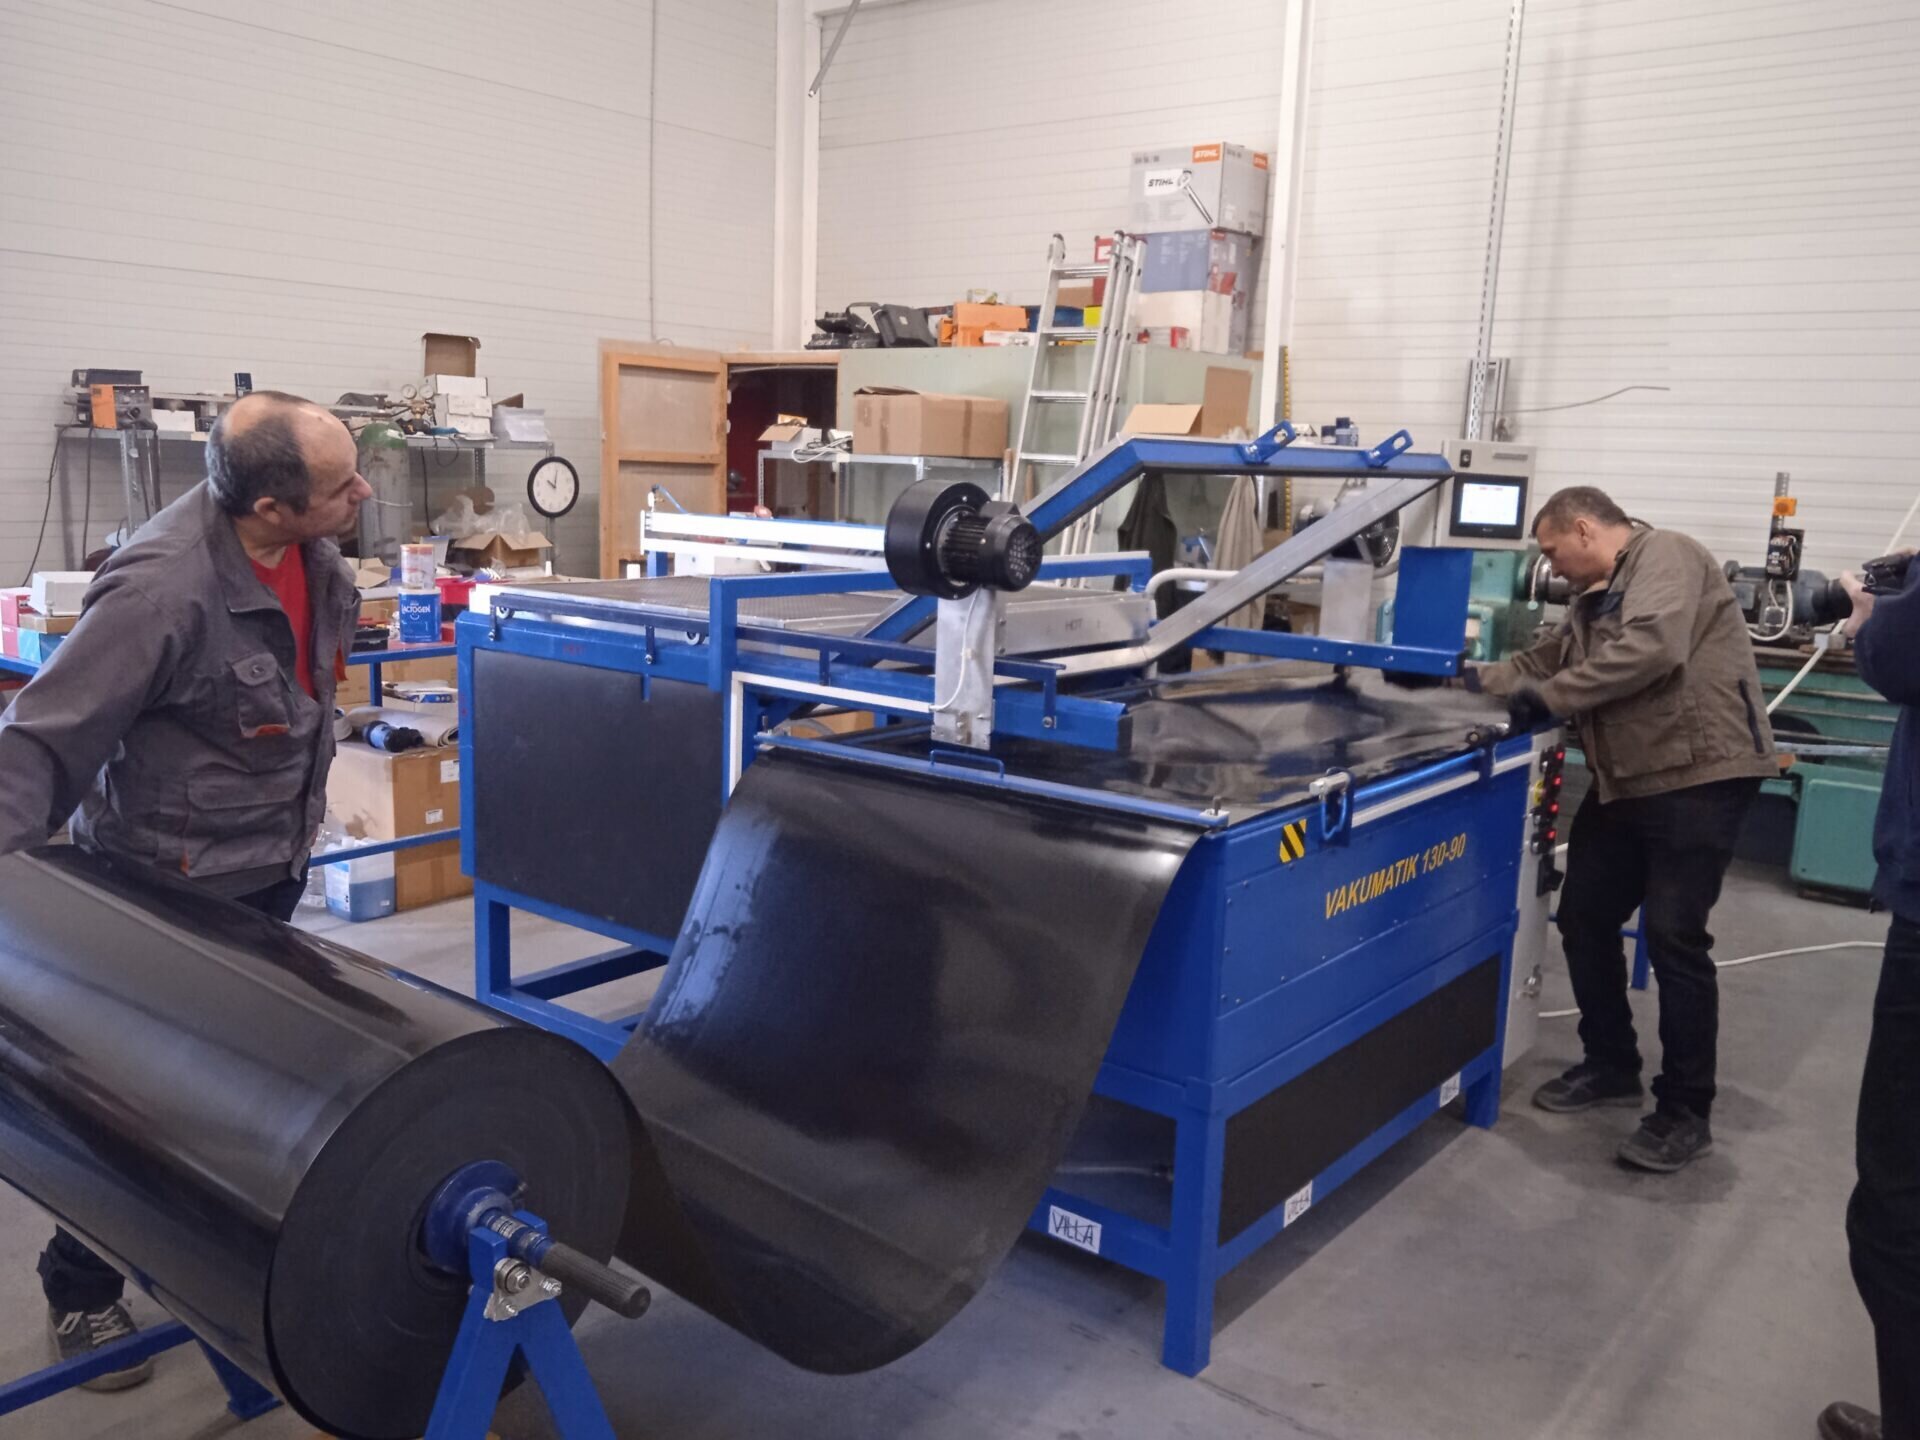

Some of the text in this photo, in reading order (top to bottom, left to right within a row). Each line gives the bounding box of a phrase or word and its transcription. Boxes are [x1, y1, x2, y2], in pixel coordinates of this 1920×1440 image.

[1194, 149, 1217, 159] STIHL
[1147, 178, 1174, 187] STIHL
[401, 604, 431, 614] LACTOGEN
[1325, 832, 1466, 919] VAKUMATIK 130-90
[1052, 1211, 1094, 1246] VILLA
